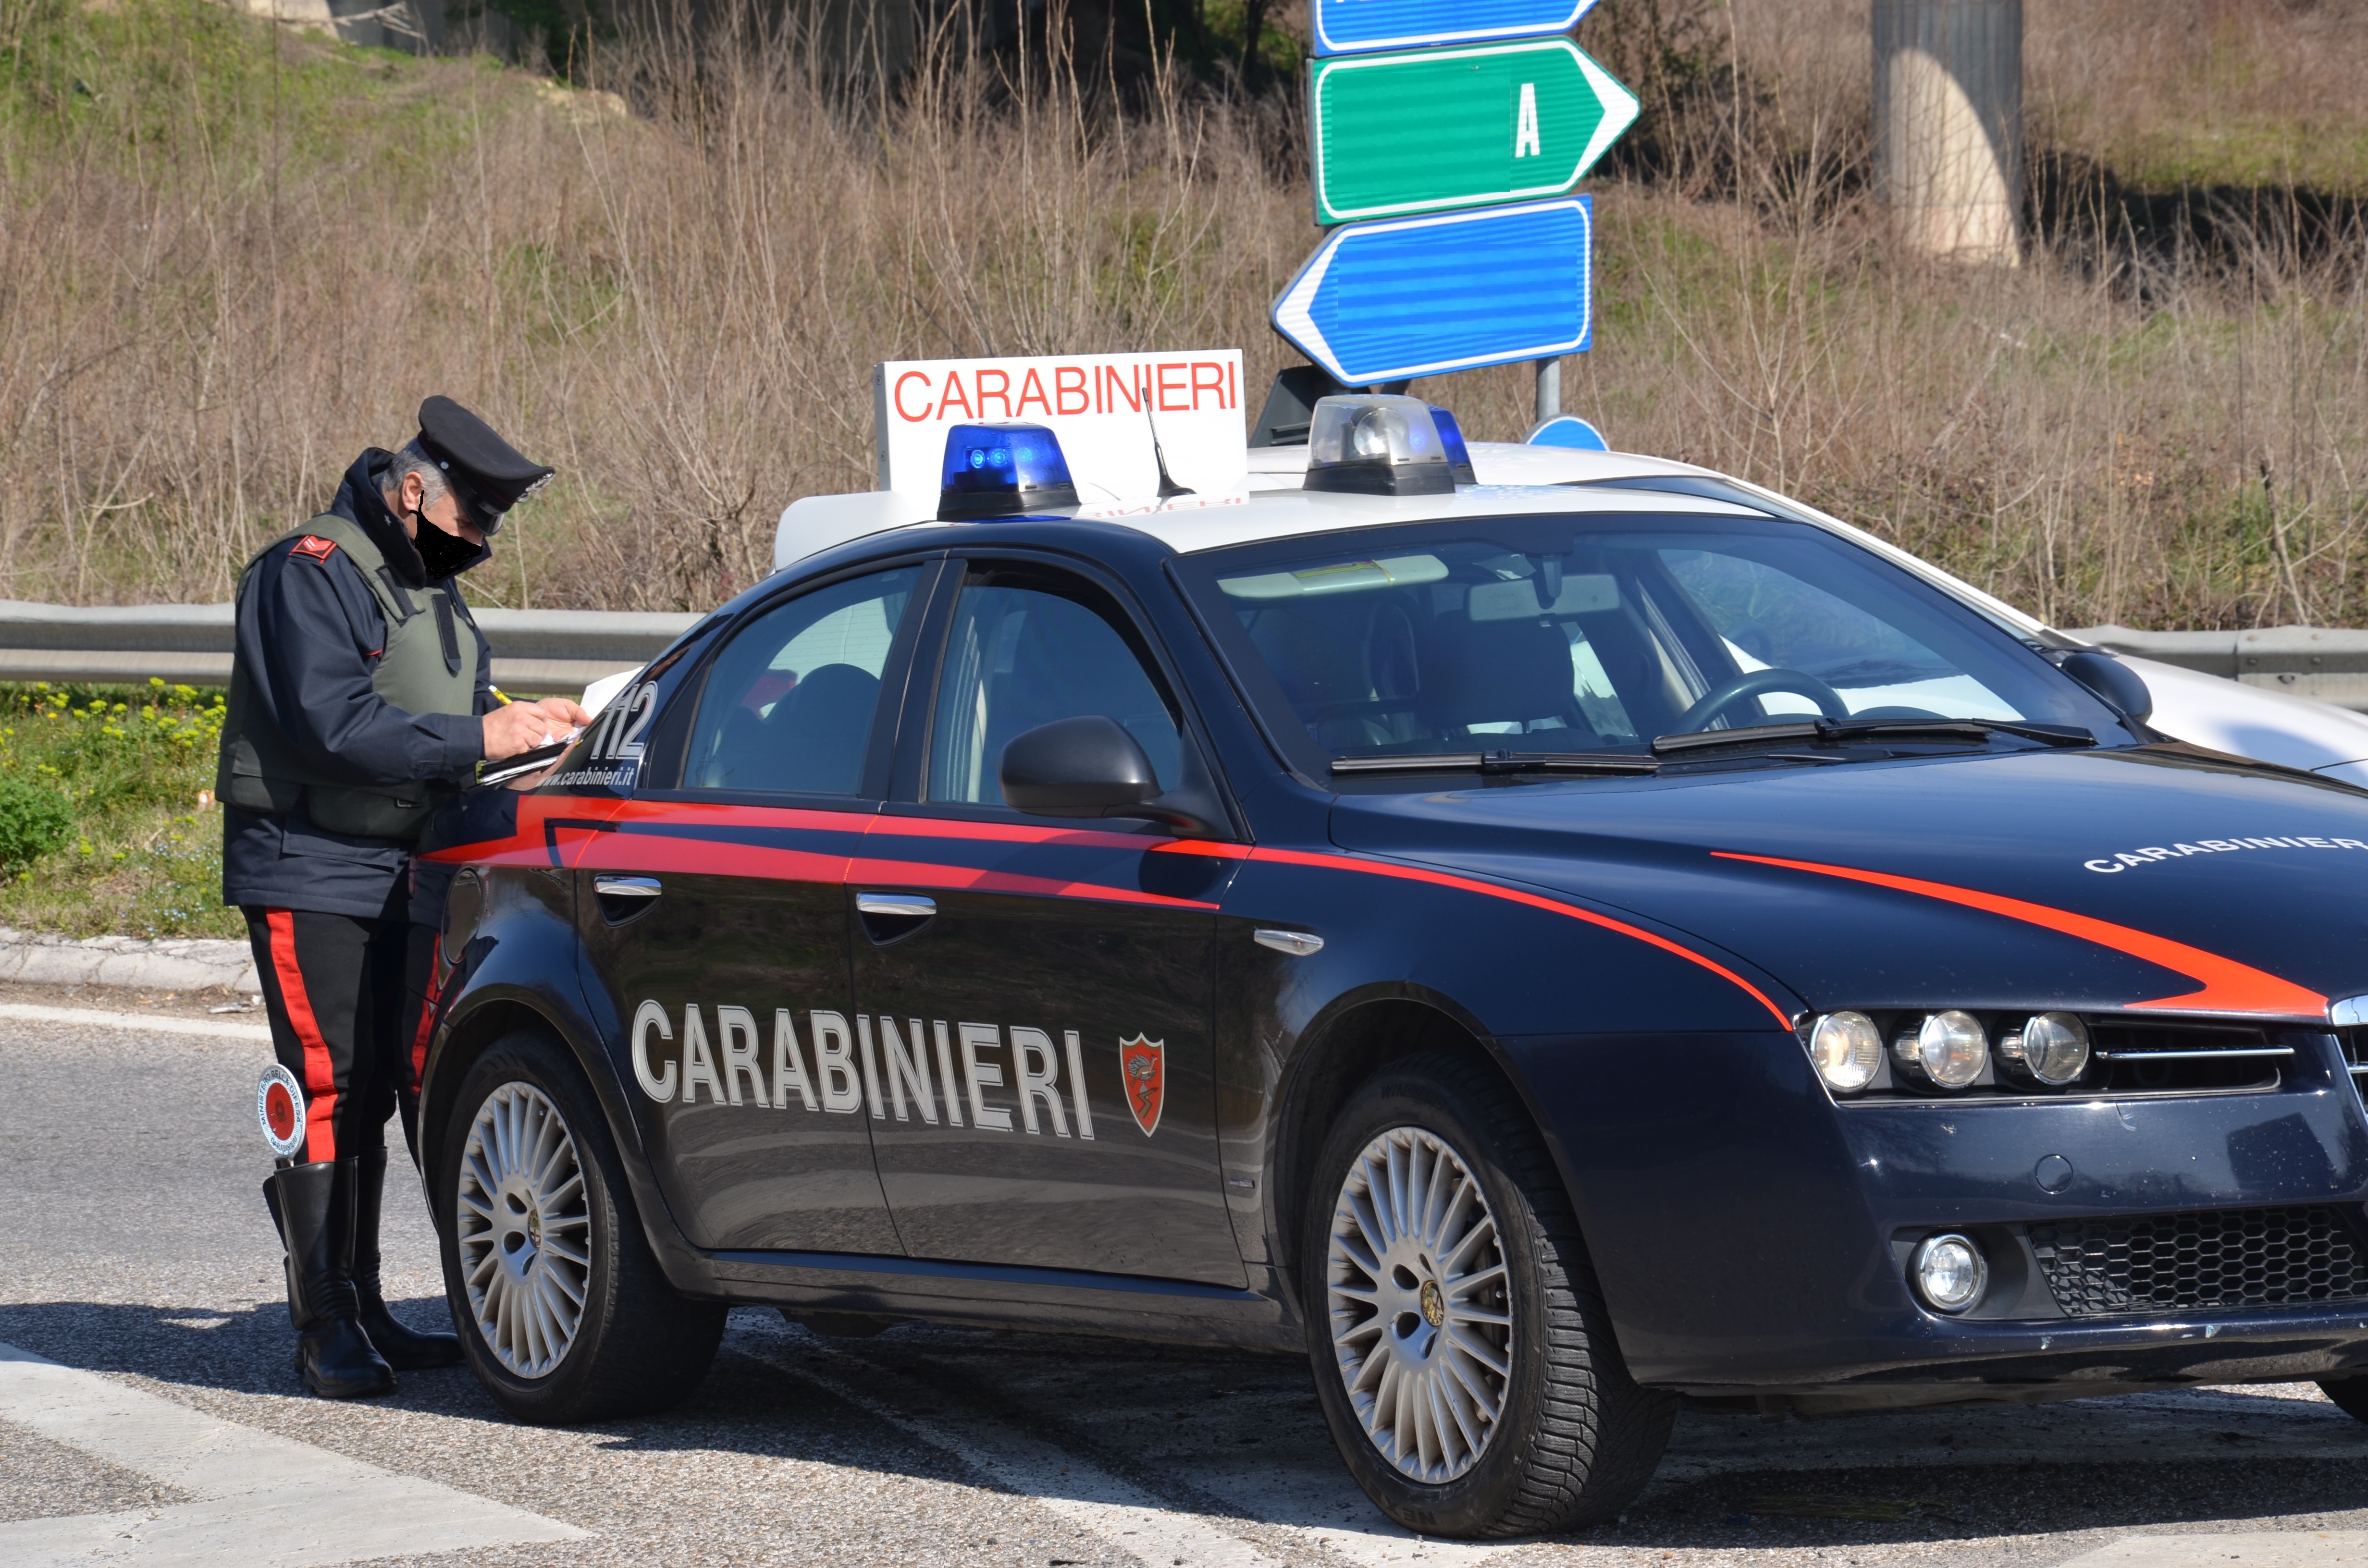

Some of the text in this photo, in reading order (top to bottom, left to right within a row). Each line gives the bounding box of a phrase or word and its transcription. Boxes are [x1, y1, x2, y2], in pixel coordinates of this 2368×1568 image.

[1515, 83, 1540, 158] A
[894, 361, 1236, 422] CARABINIERI
[590, 680, 658, 760] 112
[2083, 836, 2368, 873] CARABINIER
[259, 1070, 300, 1125] MINISTERO DELLA DIFESA
[632, 999, 1095, 1140] CARABINIERI
